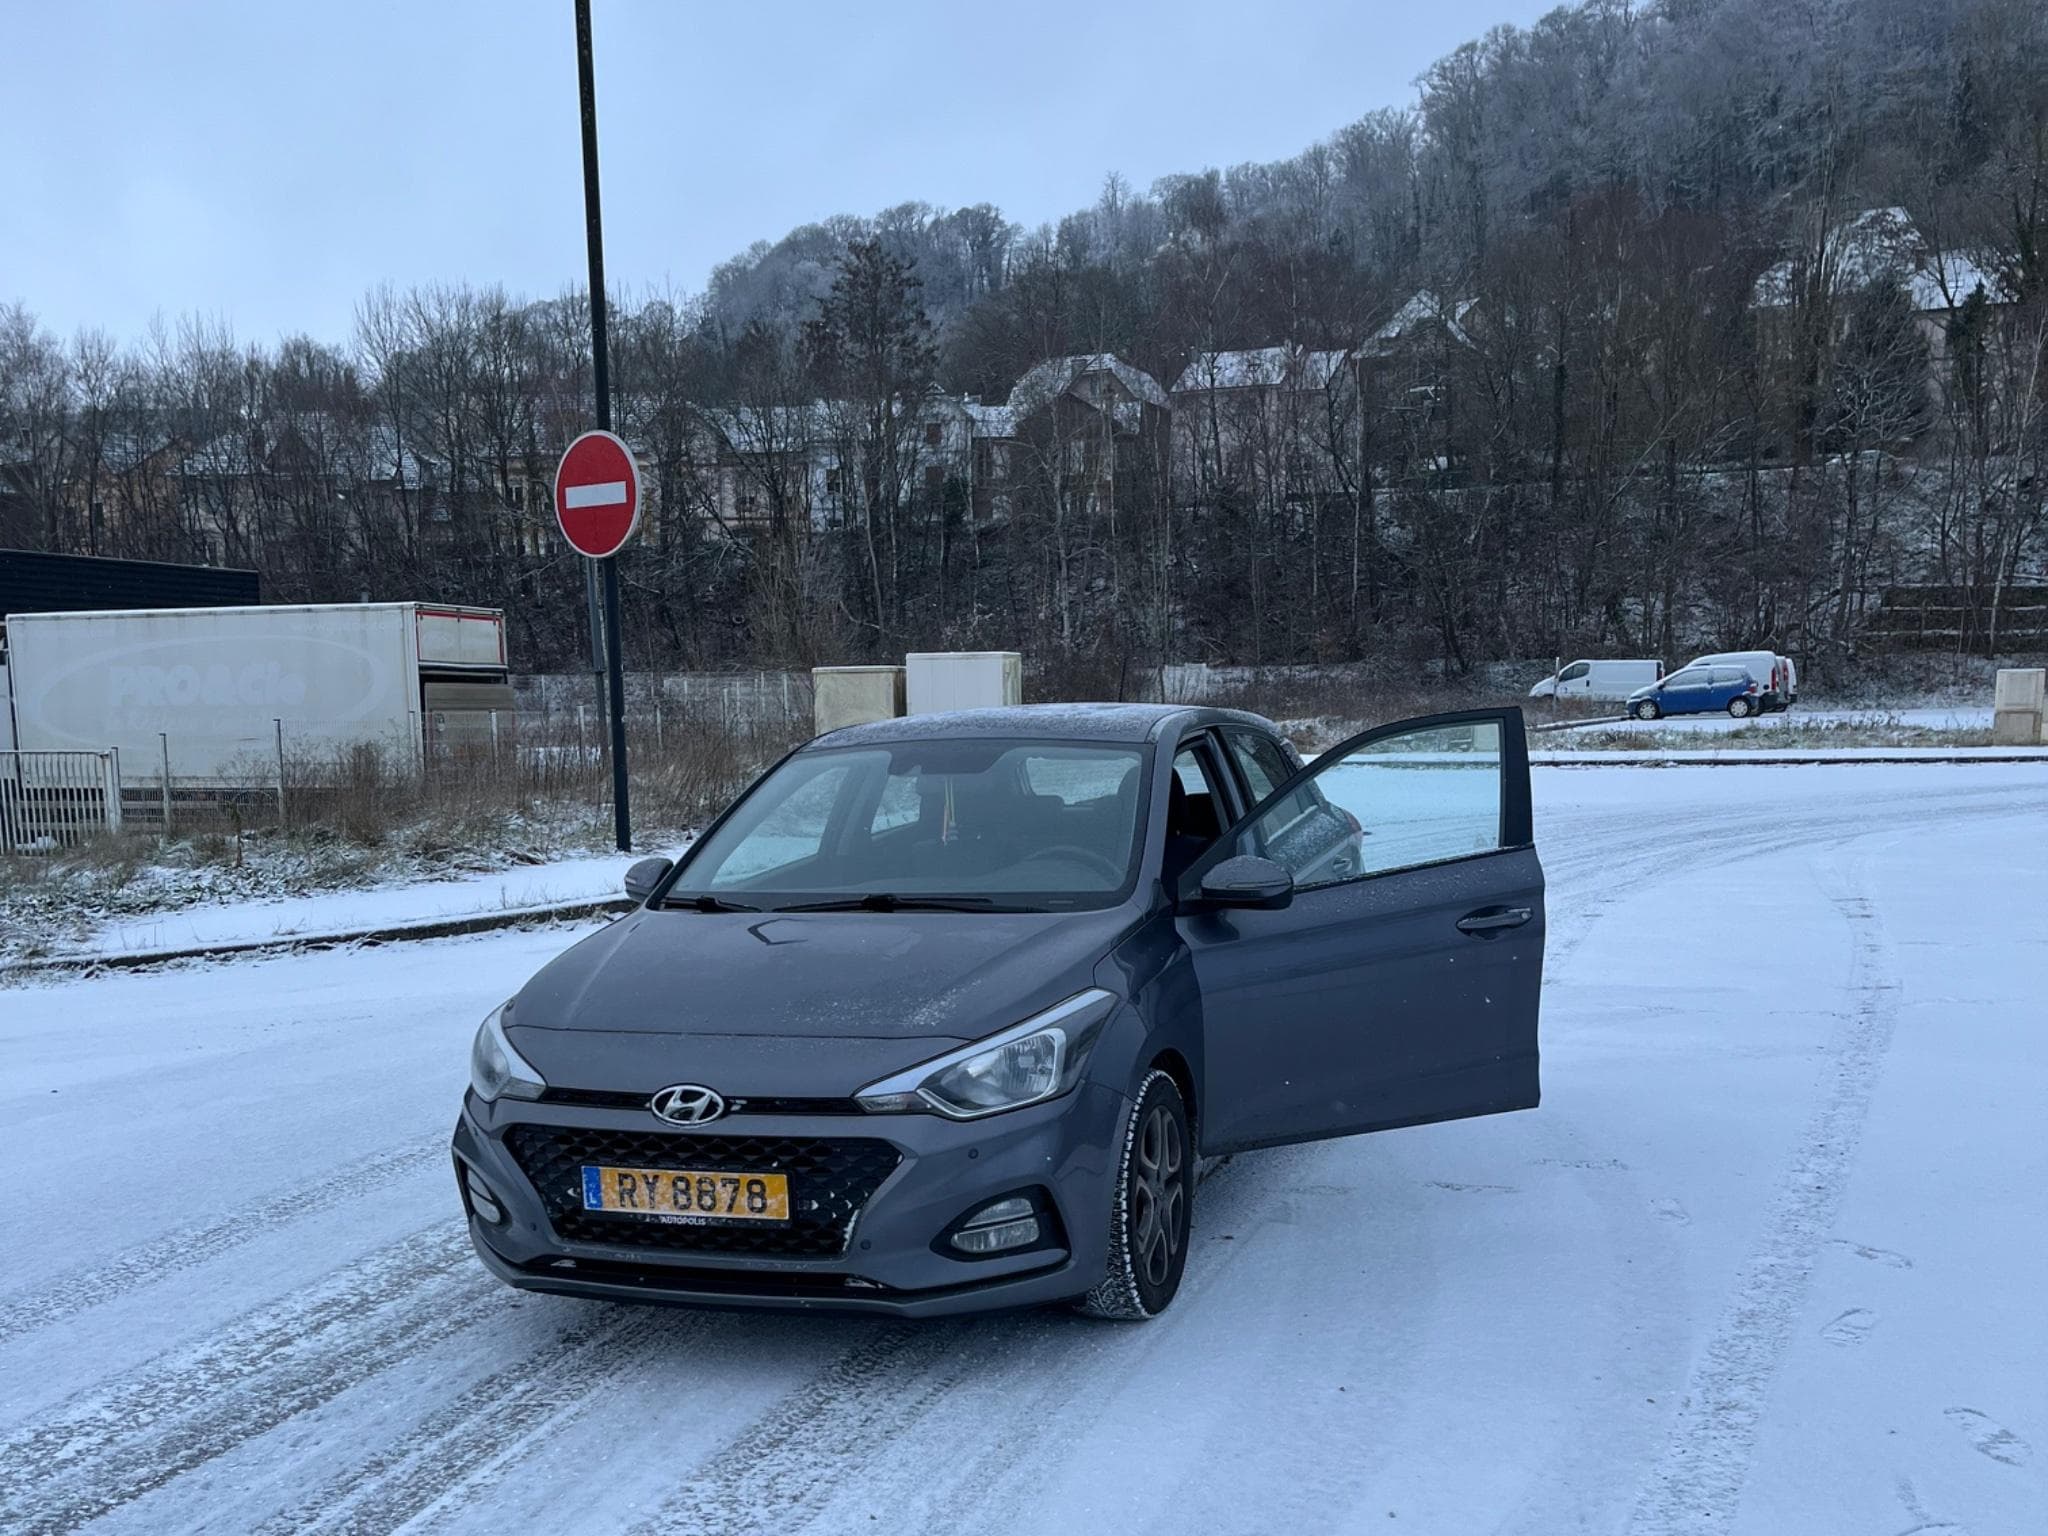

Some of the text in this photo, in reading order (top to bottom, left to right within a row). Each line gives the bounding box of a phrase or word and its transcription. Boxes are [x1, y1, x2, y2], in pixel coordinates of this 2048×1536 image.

[617, 1173, 768, 1214] RY 8878
[660, 1215, 706, 1226] AUTOPOLIS
